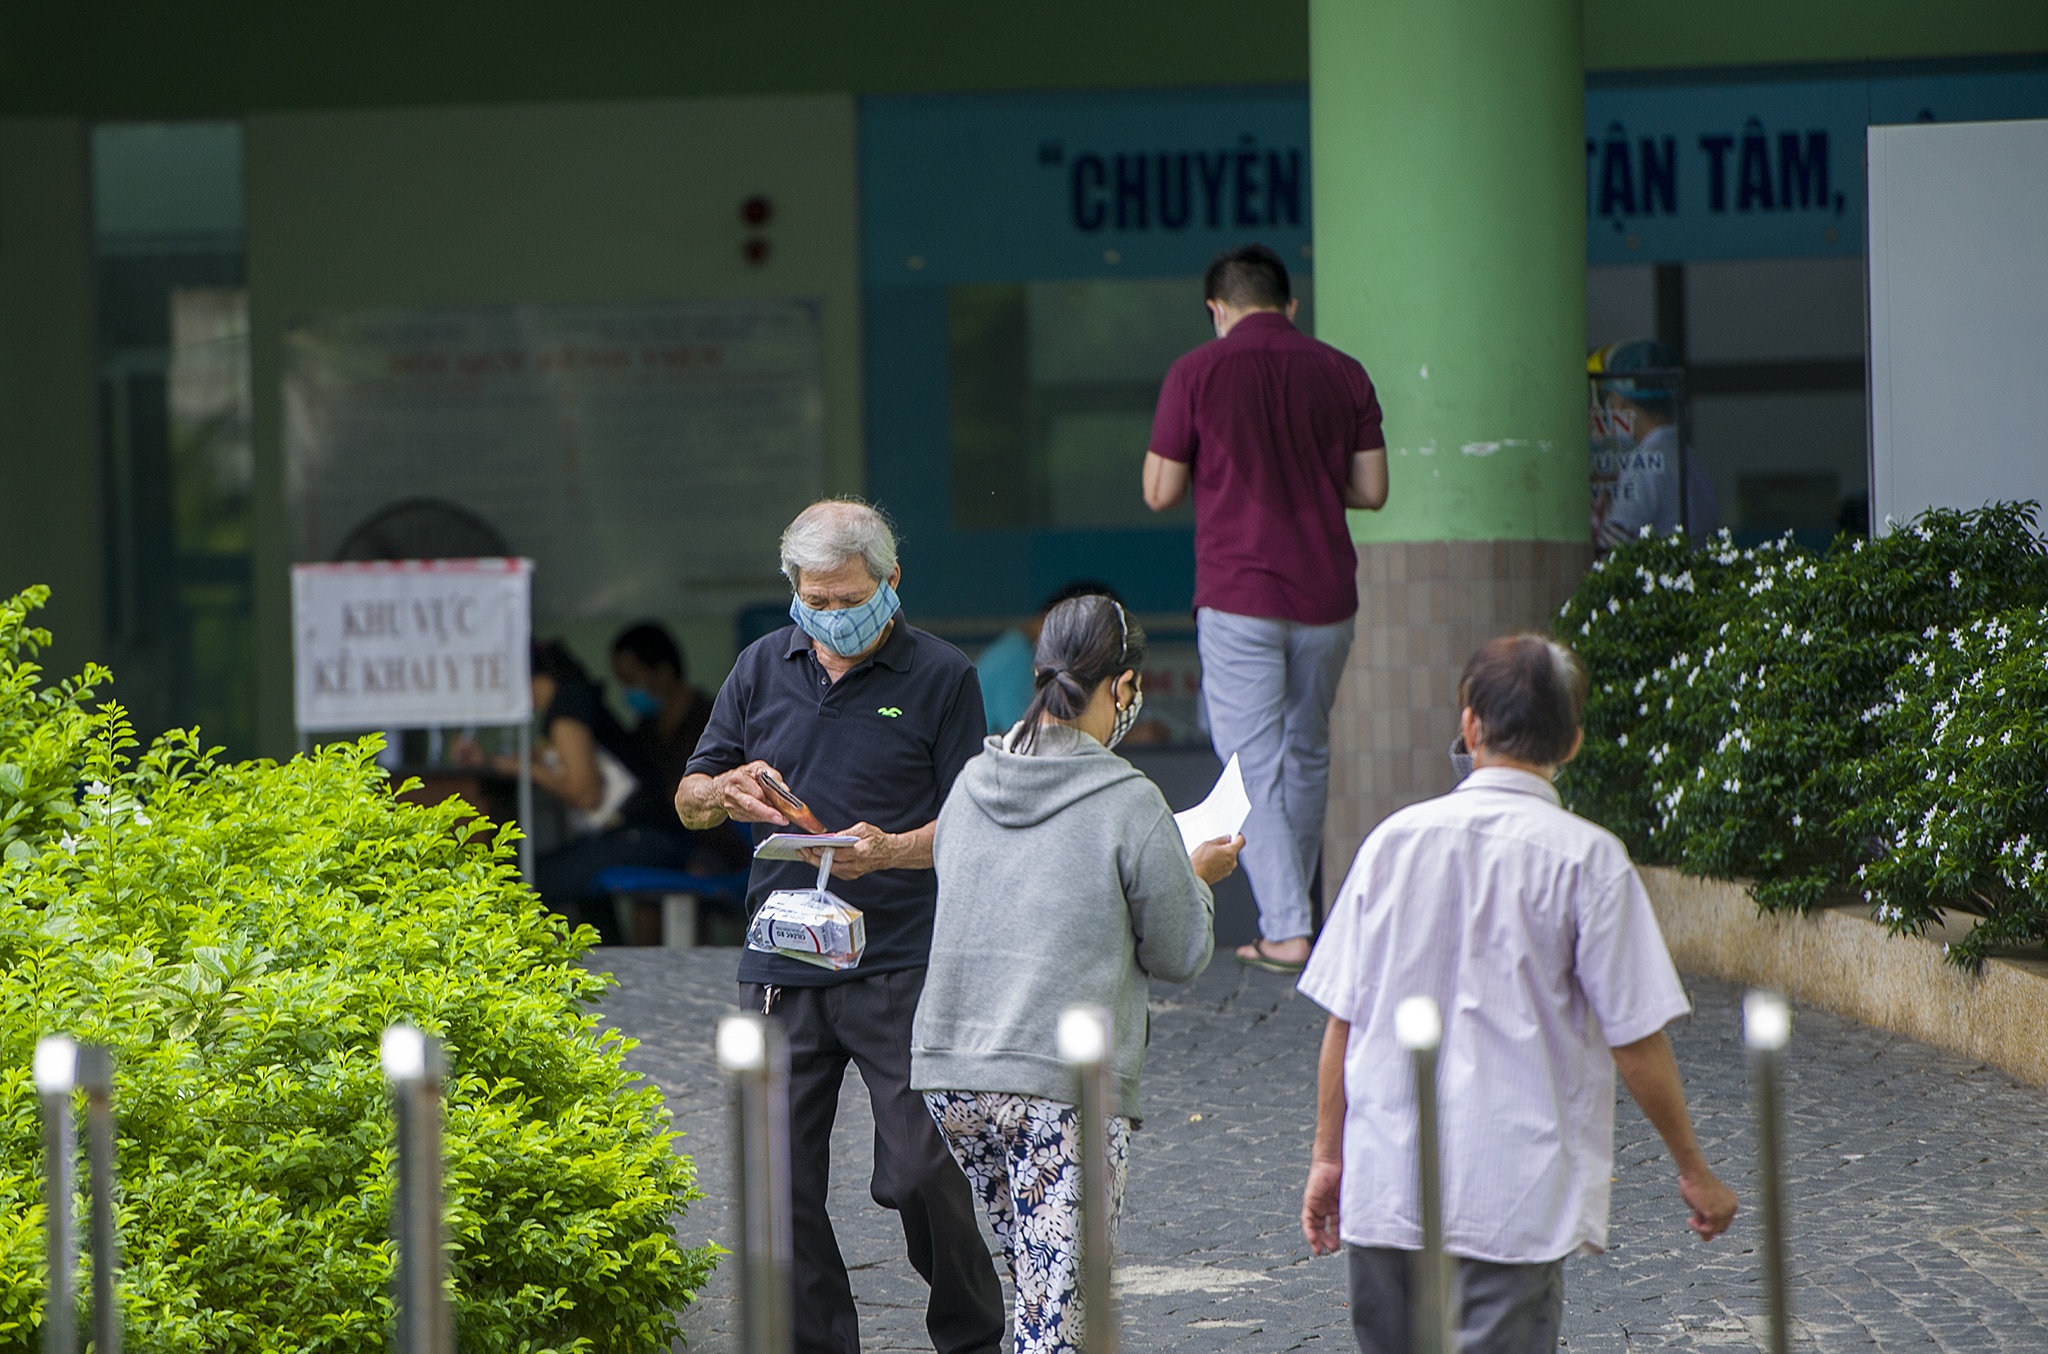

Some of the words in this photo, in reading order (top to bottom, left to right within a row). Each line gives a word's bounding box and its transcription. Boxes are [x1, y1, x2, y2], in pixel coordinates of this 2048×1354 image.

[1699, 116, 1846, 217] TÂM,
[342, 600, 406, 637] KHU
[313, 648, 353, 694] KÊ
[361, 655, 440, 693] KHAI
